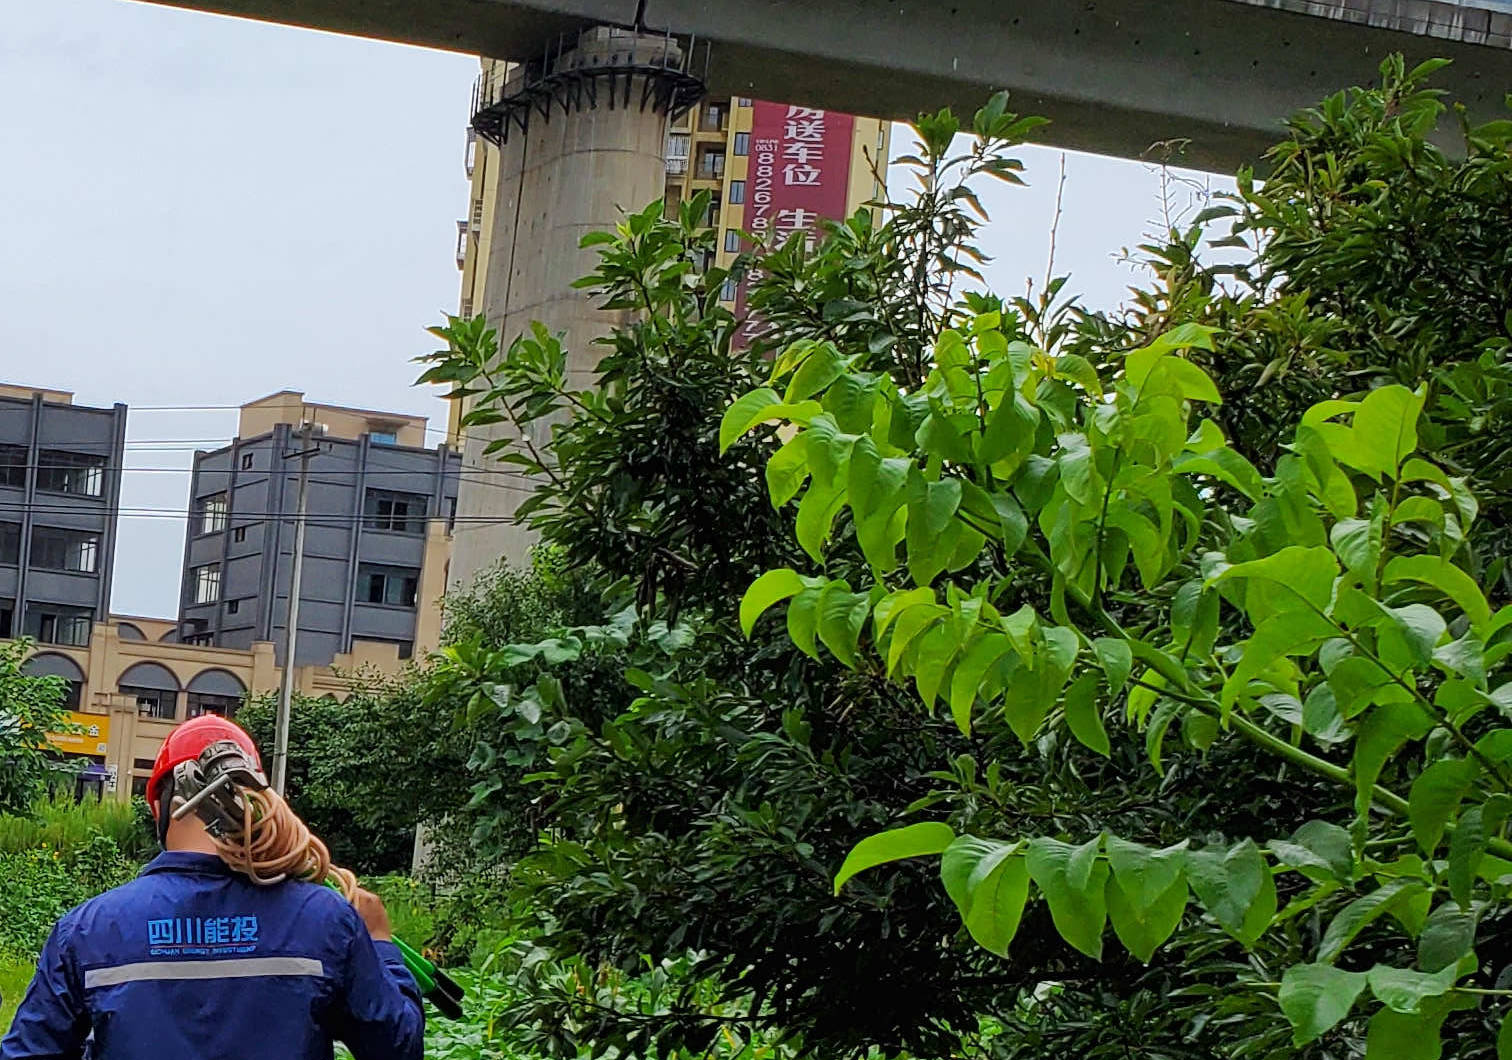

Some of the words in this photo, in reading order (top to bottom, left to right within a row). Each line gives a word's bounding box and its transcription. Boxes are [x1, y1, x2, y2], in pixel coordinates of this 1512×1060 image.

[755, 144, 778, 152] 0831
[148, 916, 259, 944] 四川能投
